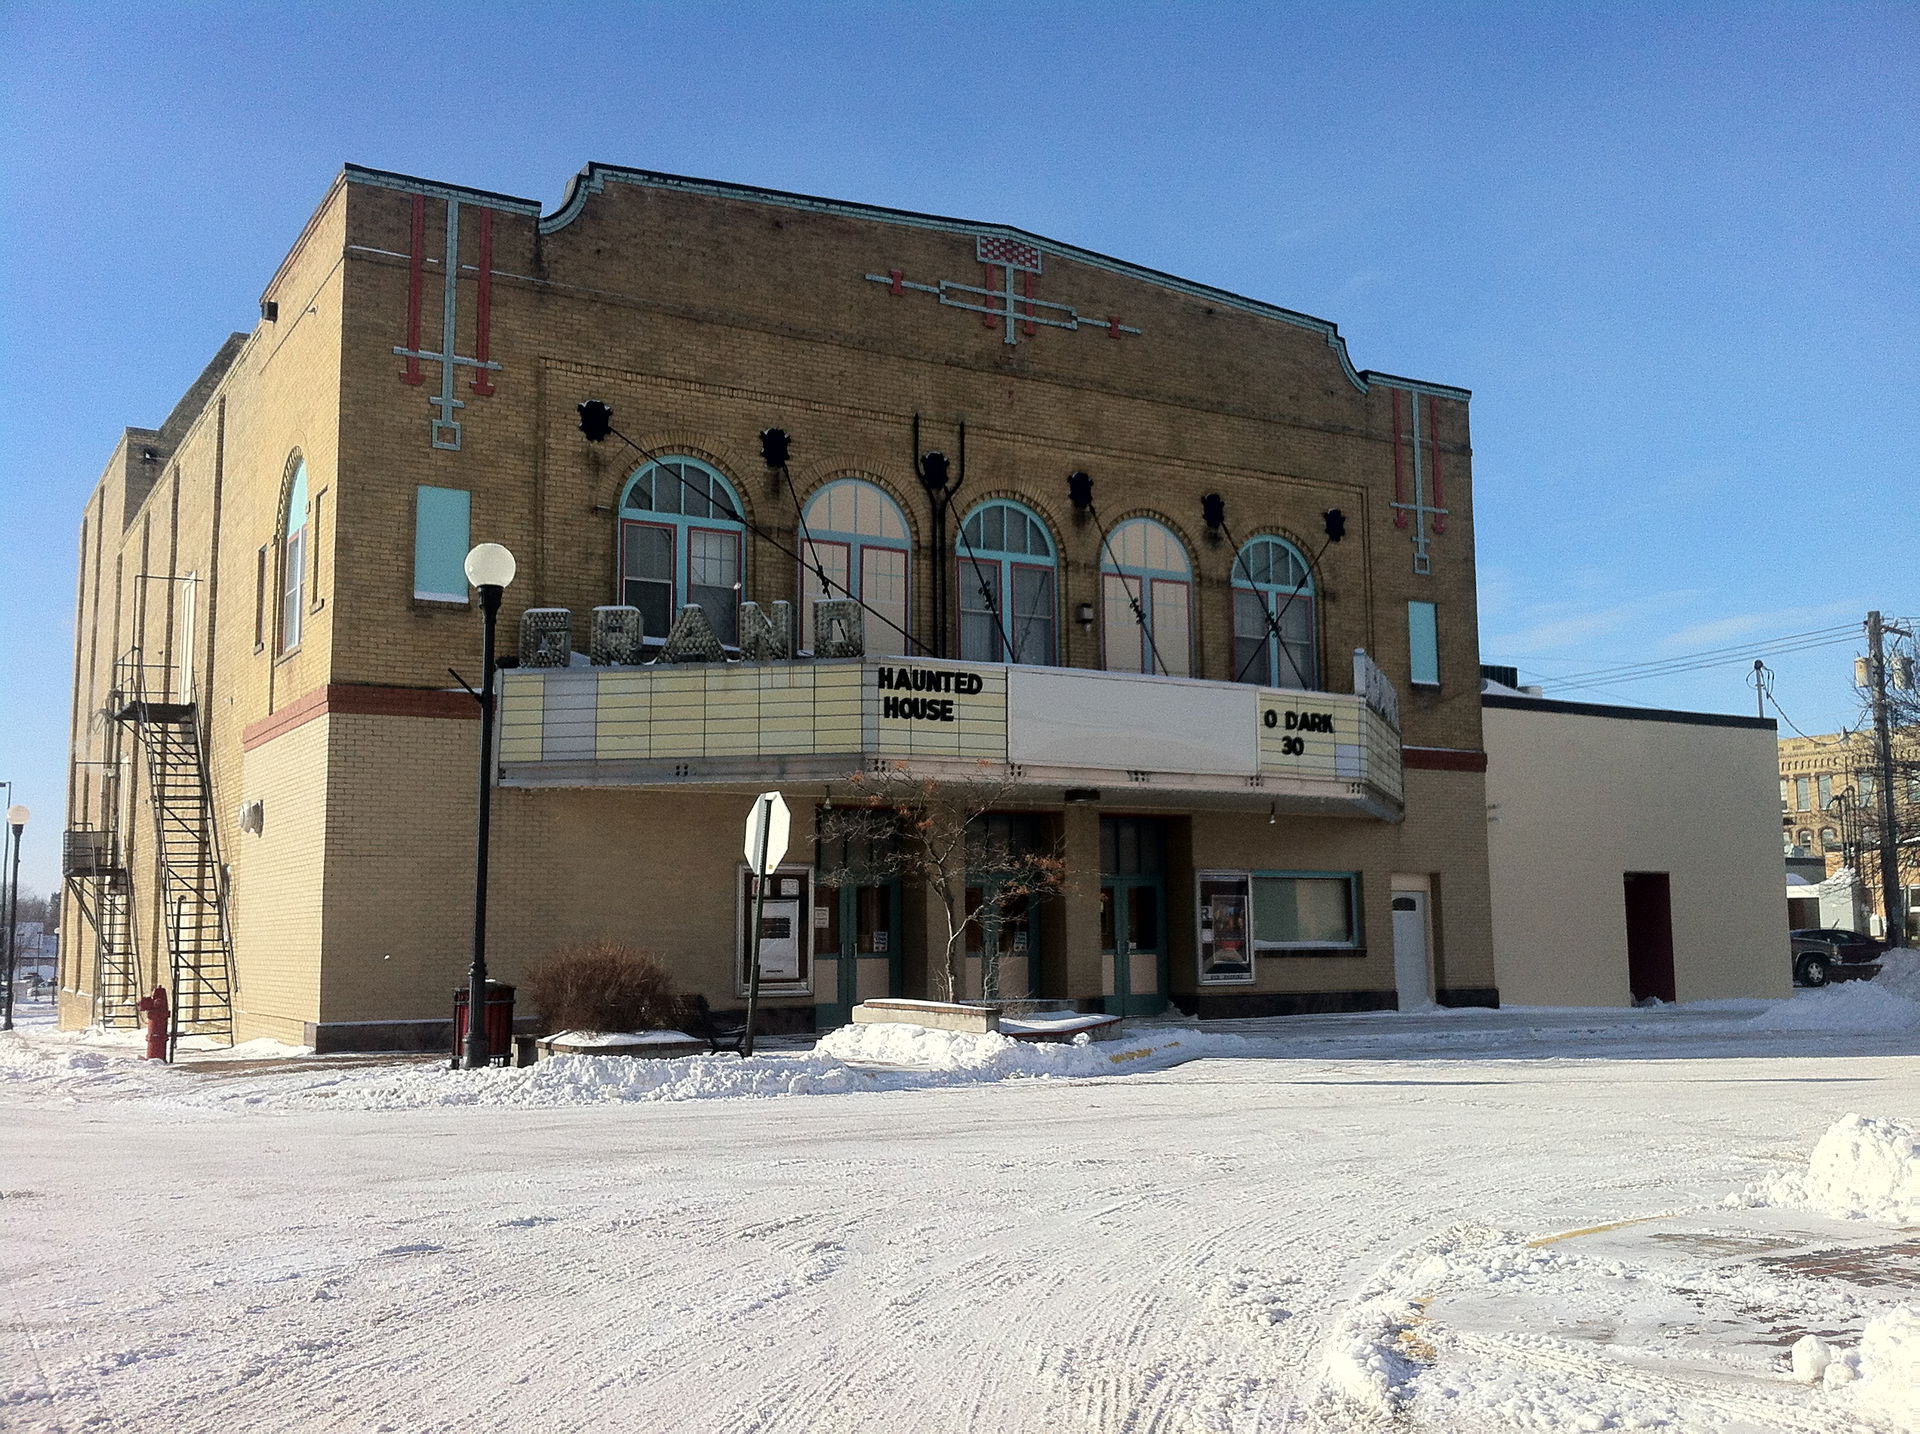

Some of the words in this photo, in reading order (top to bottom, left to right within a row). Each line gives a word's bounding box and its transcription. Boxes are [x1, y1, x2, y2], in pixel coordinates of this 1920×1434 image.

[519, 600, 866, 669] GRAND
[878, 667, 984, 695] HAUNTED
[883, 696, 954, 722] HOUSE
[1284, 710, 1334, 734] DARK
[1281, 735, 1305, 756] 30
